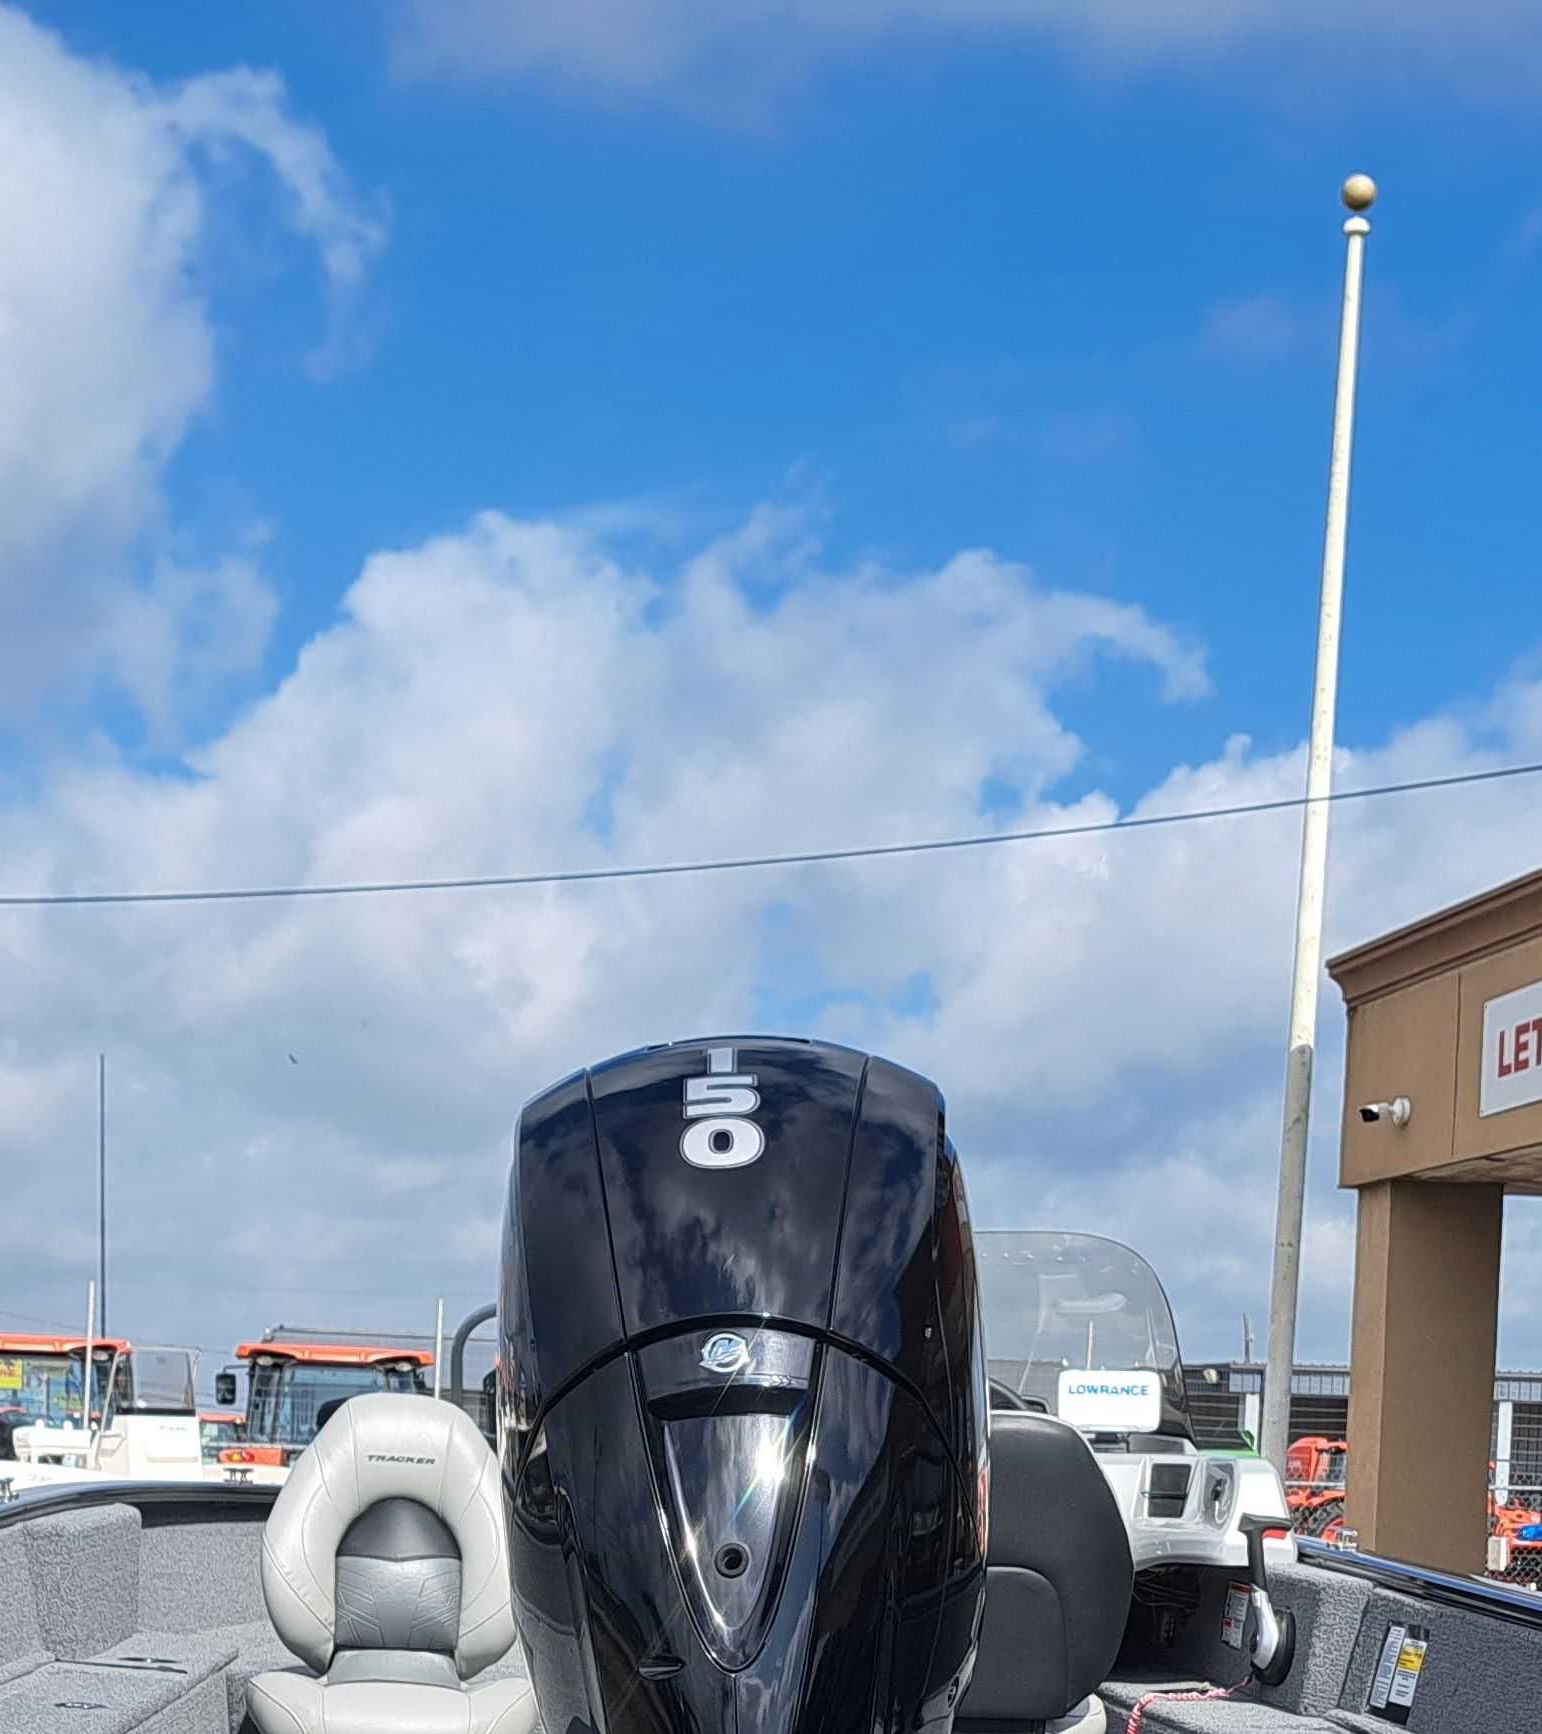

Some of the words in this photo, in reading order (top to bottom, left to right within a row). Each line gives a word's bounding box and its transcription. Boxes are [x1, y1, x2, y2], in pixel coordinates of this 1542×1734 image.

[679, 1047, 766, 1169] 150
[1067, 1383, 1150, 1397] LOWRANCE
[367, 1453, 436, 1466] TRACKER
